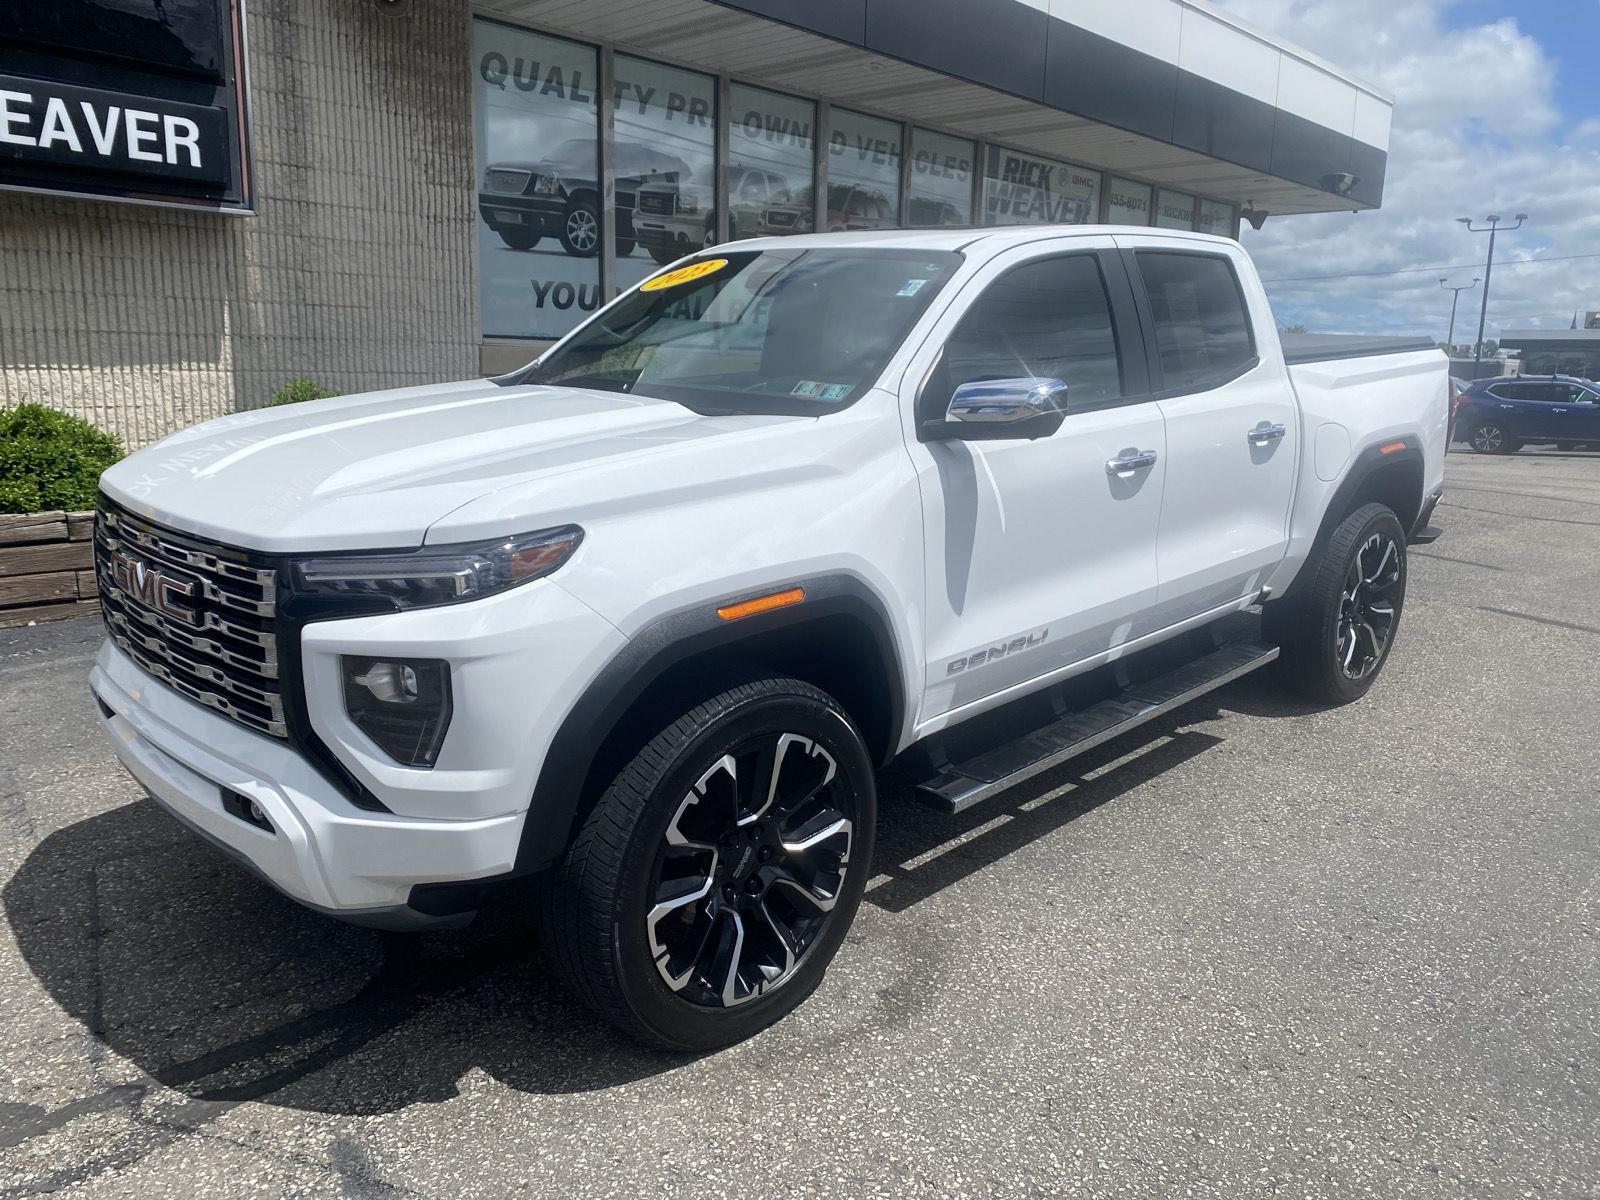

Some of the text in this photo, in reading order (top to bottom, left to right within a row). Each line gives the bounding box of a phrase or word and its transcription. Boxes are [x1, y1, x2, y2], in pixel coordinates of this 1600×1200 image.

[480, 51, 970, 182] QUALTY PR-OWND VEHCLES
[1003, 155, 1056, 191] RICK
[1072, 174, 1094, 188] GMC
[989, 181, 1091, 224] WEAVER
[111, 552, 194, 622] GMC
[946, 628, 1049, 676] DENALI
